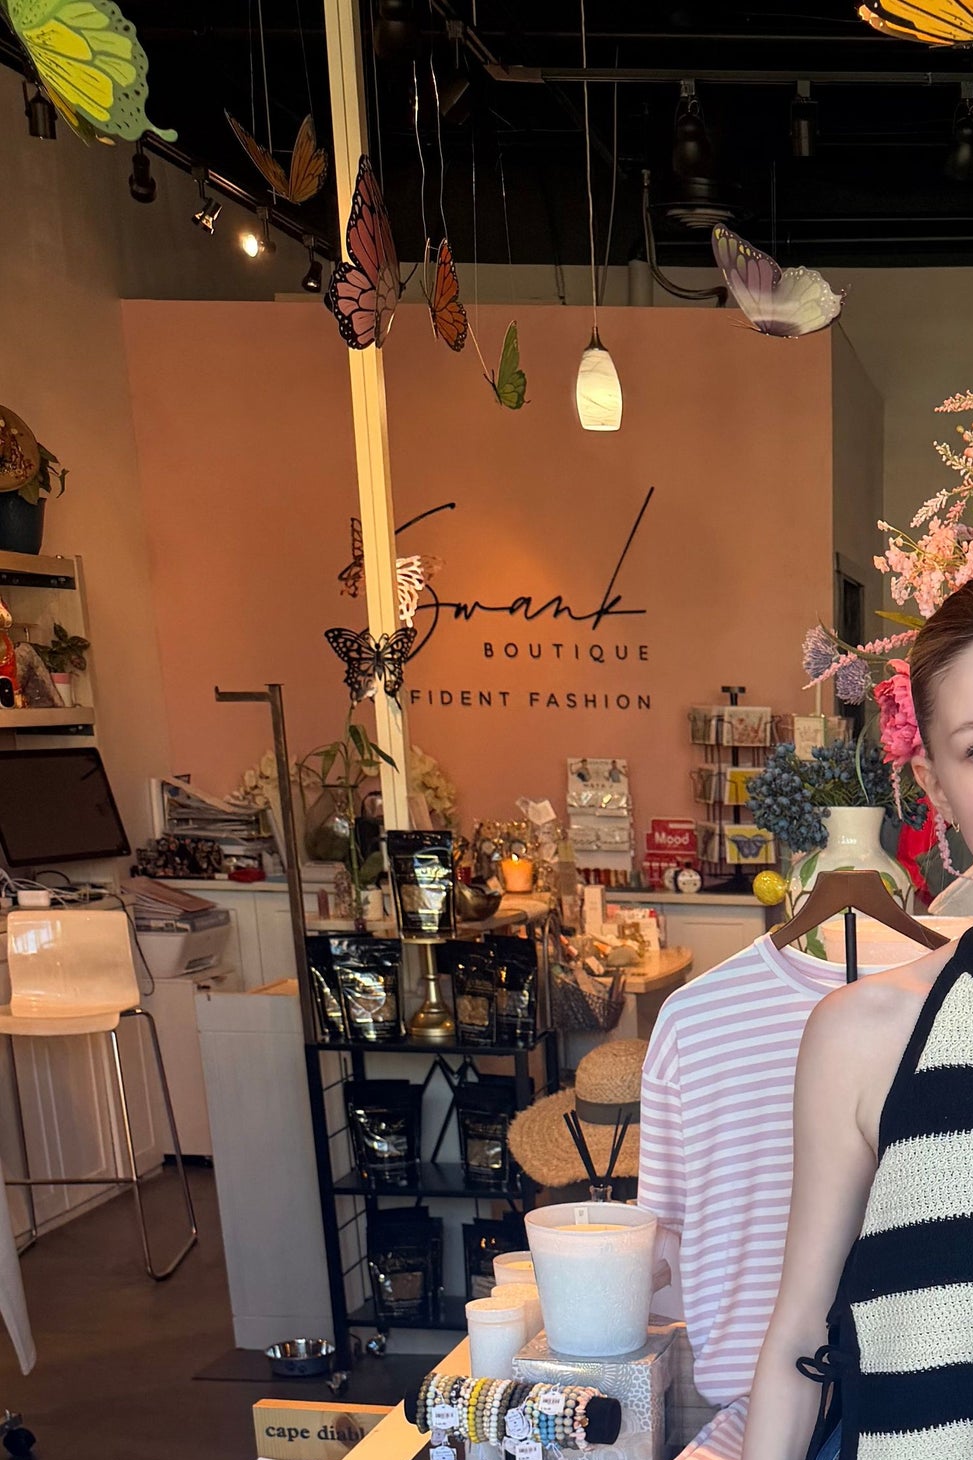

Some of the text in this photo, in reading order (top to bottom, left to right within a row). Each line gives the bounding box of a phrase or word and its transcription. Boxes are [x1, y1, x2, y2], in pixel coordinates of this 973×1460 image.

[483, 641, 650, 662] BOUTIQUE
[410, 689, 651, 710] FIDENT FASHION
[654, 831, 690, 845] Mood
[265, 1425, 310, 1442] cape
